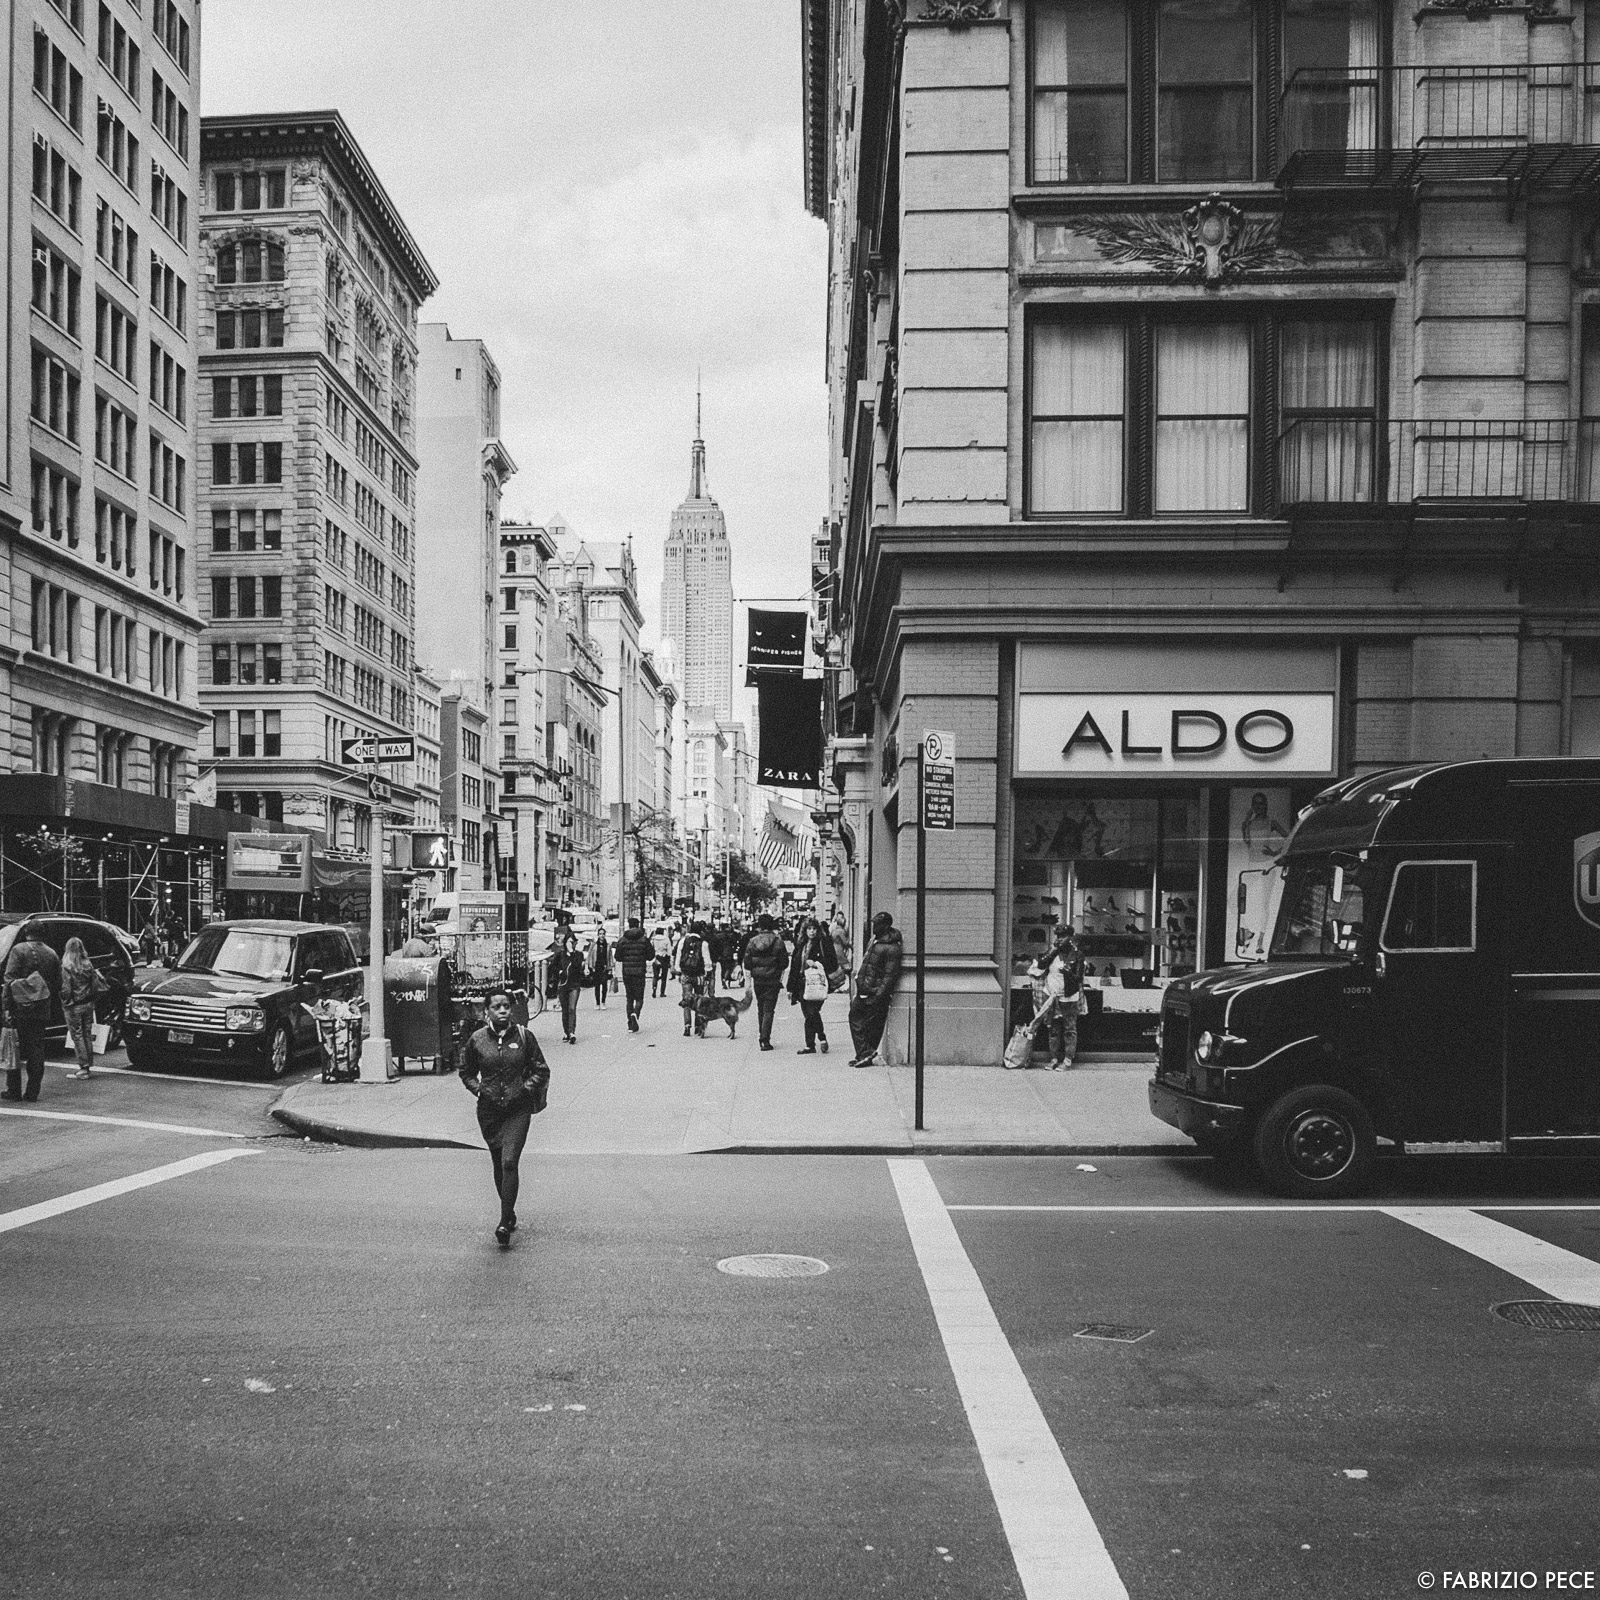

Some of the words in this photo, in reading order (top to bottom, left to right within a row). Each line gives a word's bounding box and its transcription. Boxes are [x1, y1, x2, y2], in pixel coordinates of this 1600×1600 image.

[1061, 709, 1294, 754] ALDO
[355, 746, 375, 756] ONE
[385, 744, 406, 755] WAY
[764, 767, 812, 781] ZARA
